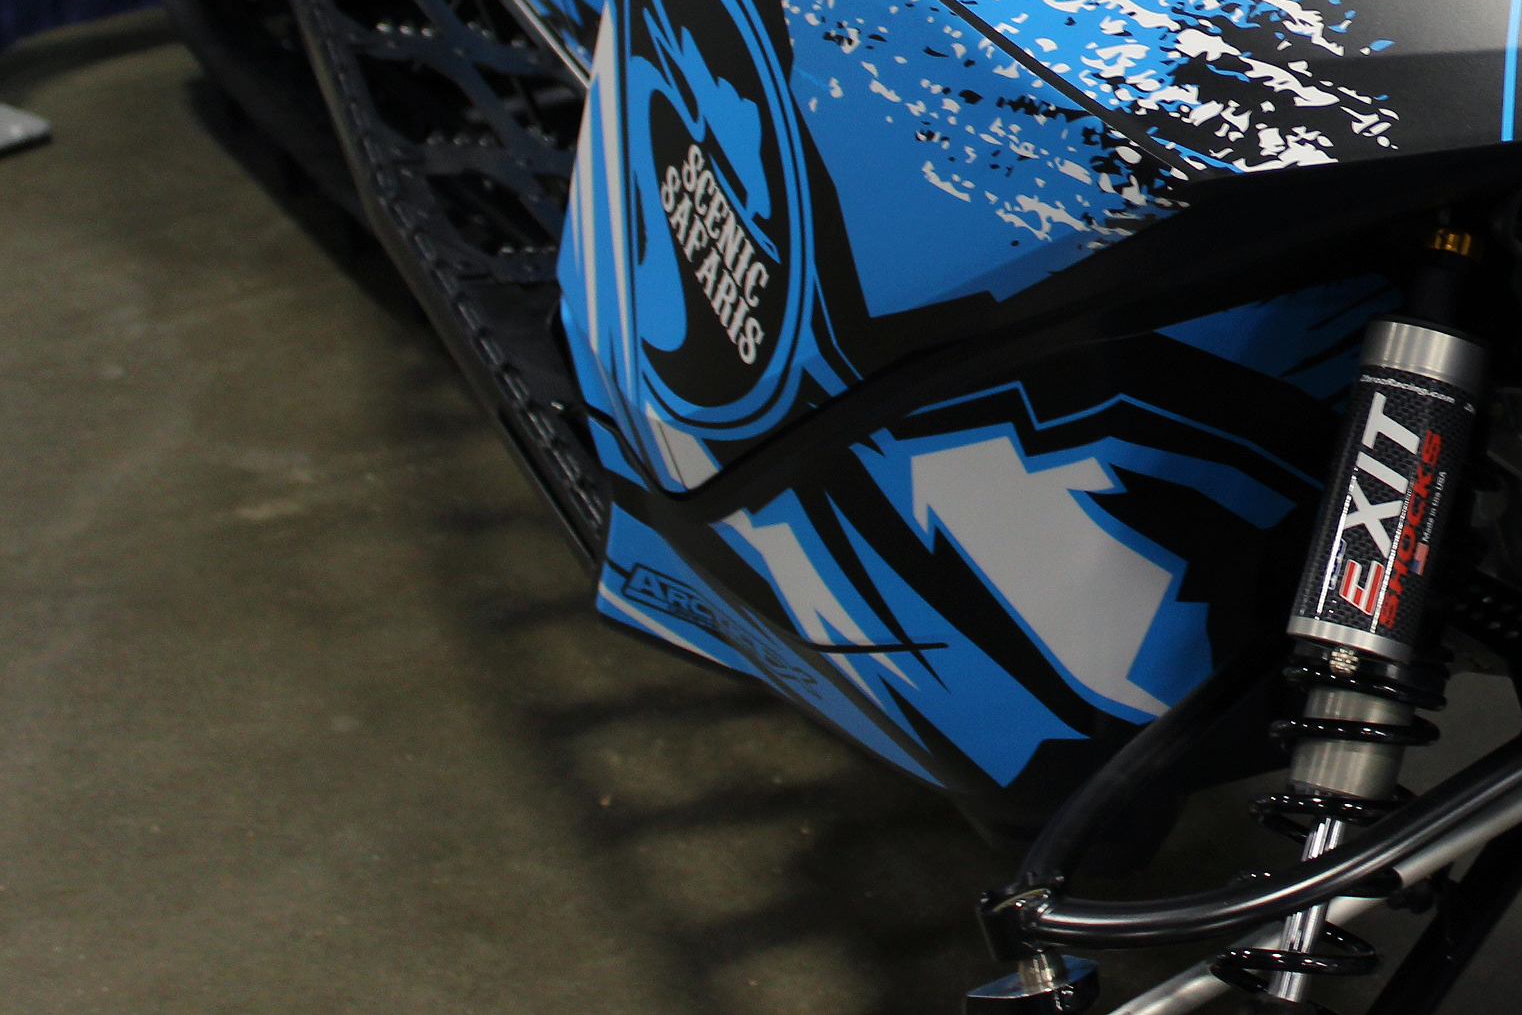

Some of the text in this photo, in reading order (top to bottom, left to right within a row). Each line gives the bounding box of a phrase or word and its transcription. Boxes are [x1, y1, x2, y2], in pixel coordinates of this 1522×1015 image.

[660, 143, 770, 366] SCENIC SAFARIS
[1328, 390, 1422, 617] EXIT
[1377, 428, 1443, 630] SHOCKS
